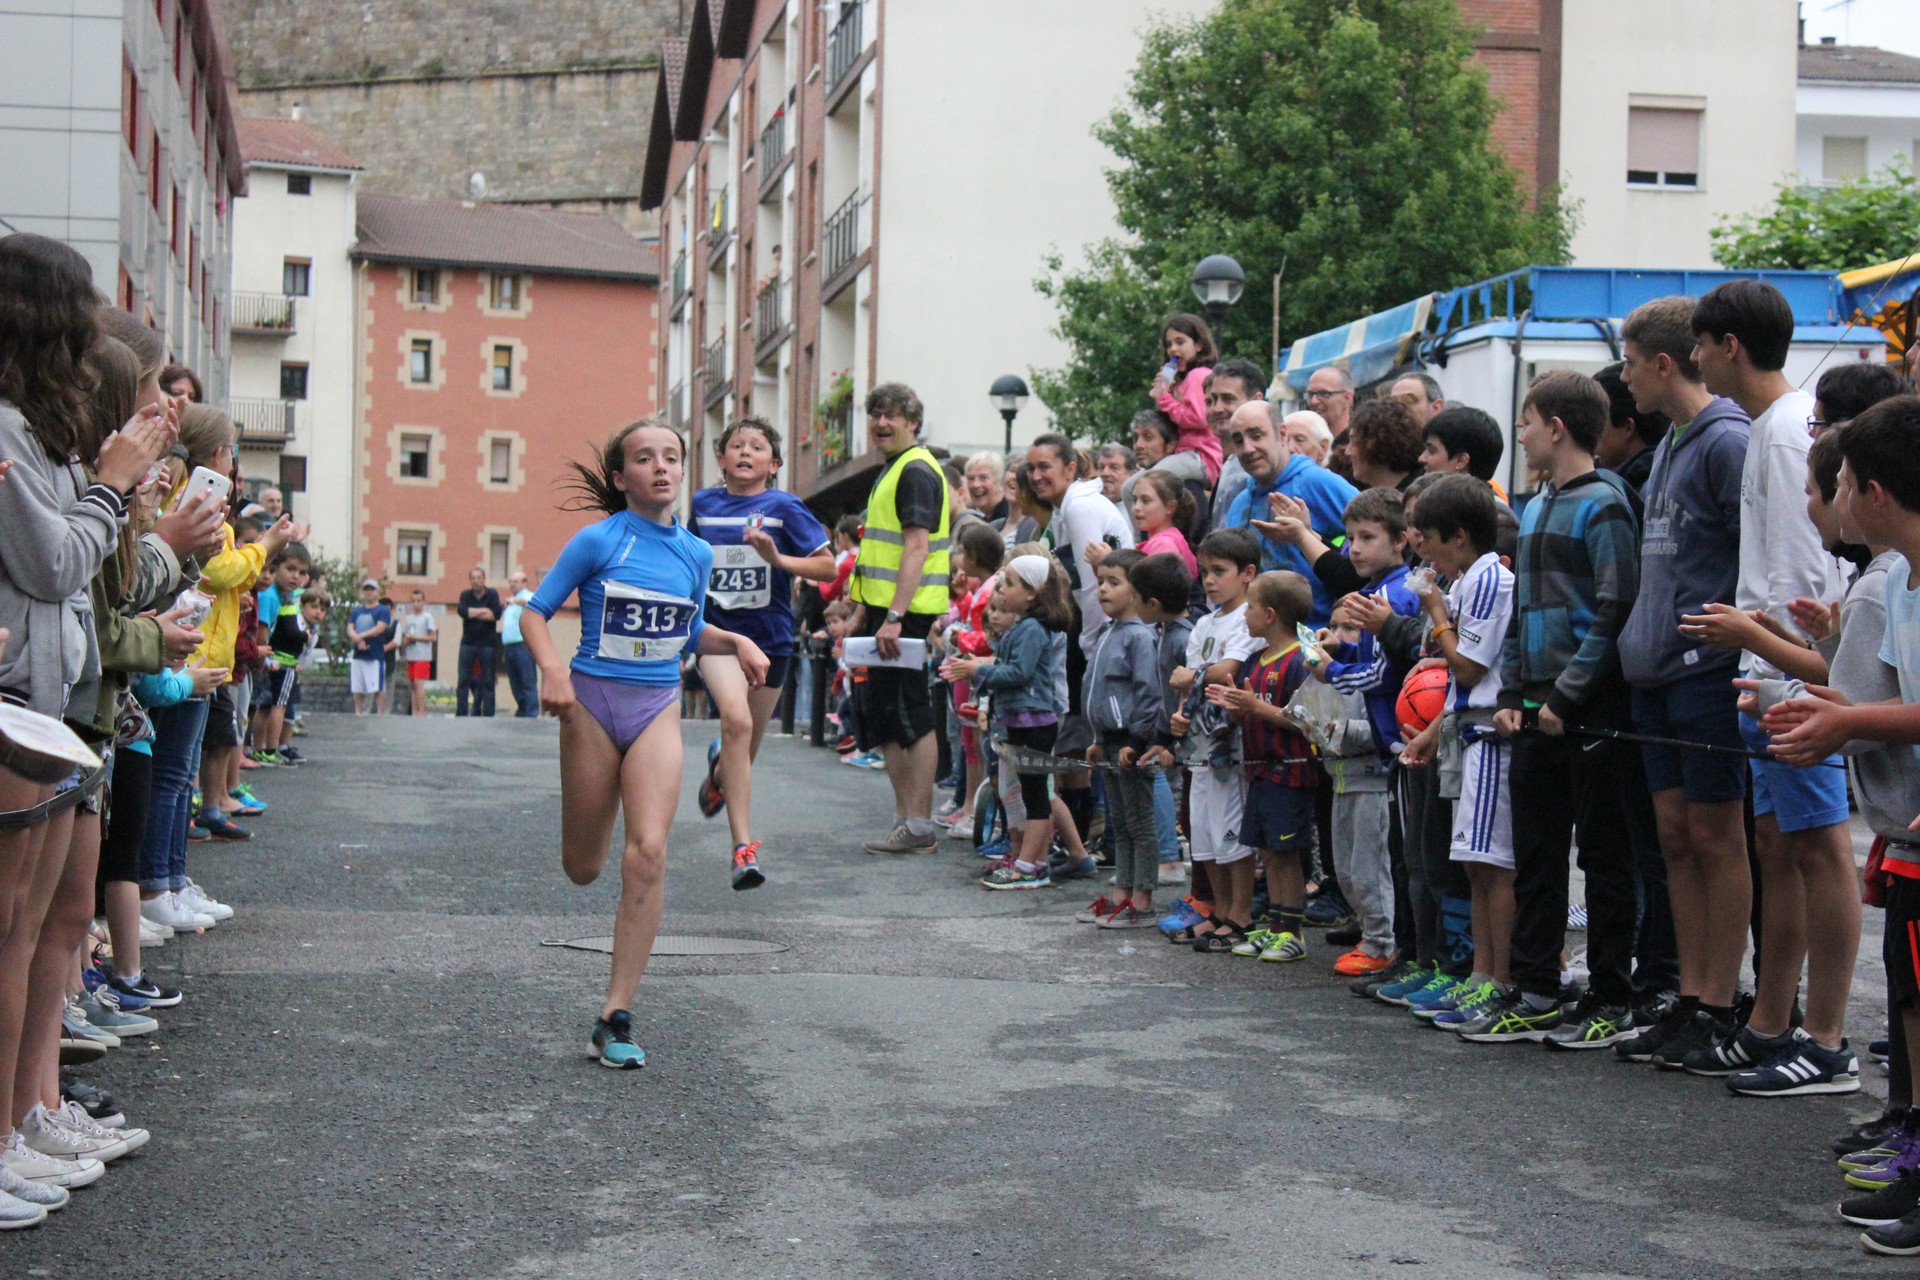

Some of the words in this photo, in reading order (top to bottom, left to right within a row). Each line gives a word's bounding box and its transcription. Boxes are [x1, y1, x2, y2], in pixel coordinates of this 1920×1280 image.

[716, 569, 758, 591] 243
[623, 603, 678, 633] 313
[1459, 628, 1481, 643] CANAL+
